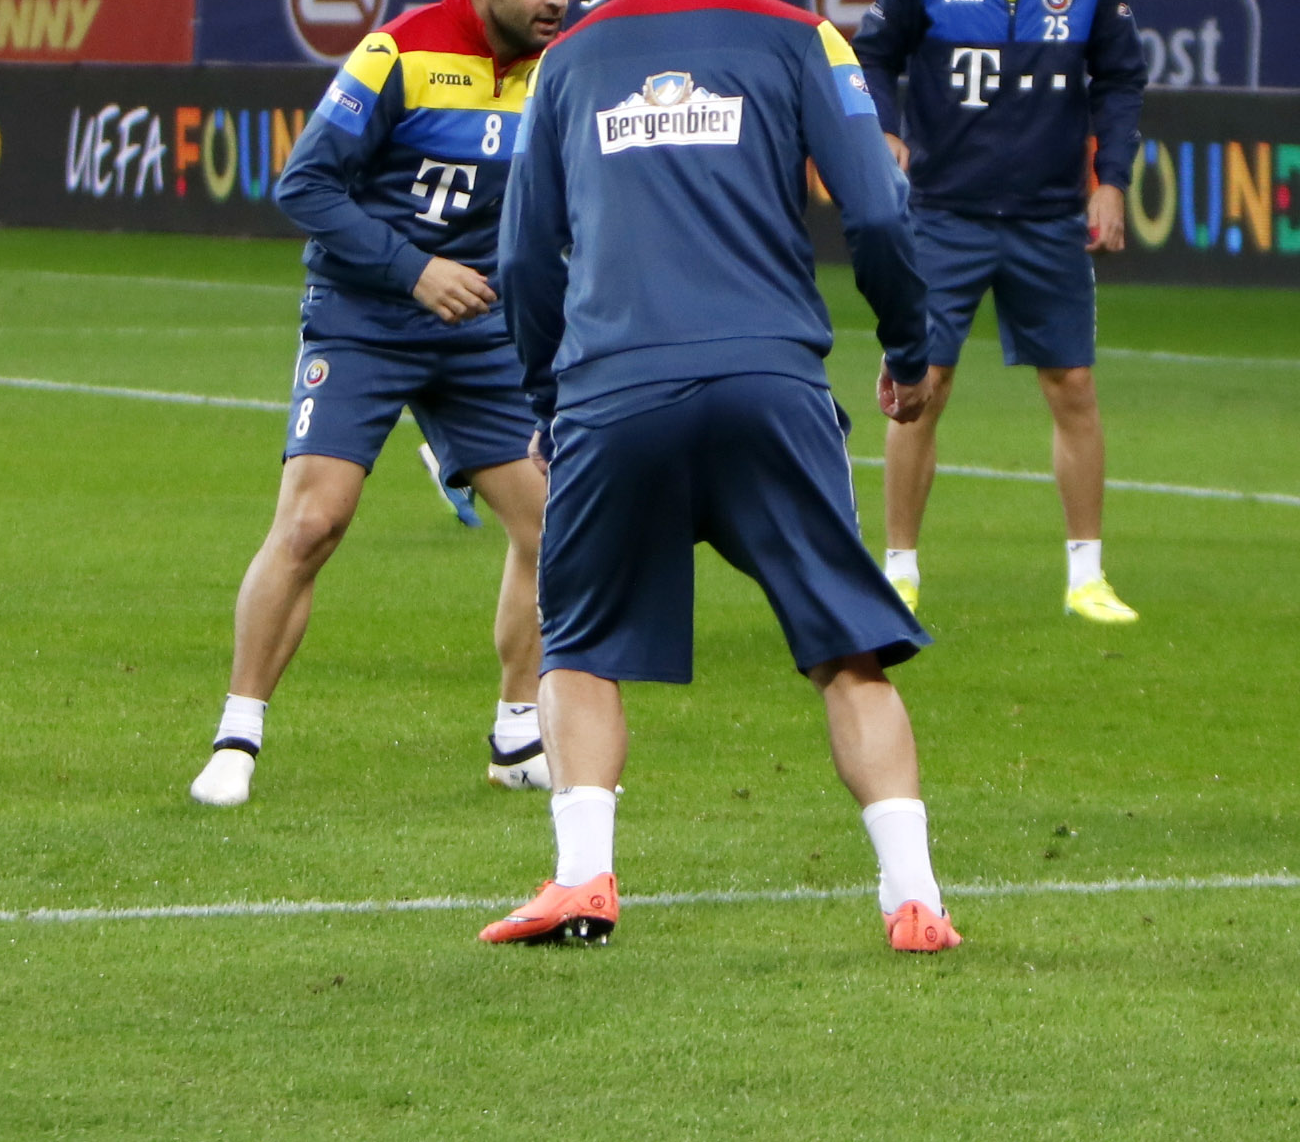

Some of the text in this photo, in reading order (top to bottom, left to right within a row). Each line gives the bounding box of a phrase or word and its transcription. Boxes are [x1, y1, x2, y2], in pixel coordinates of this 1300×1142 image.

[1043, 15, 1070, 40] 25
[481, 113, 503, 156] 8
[606, 105, 736, 143] Bergenbier
[65, 102, 312, 203] UEFA FOUN
[295, 397, 315, 439] 8
